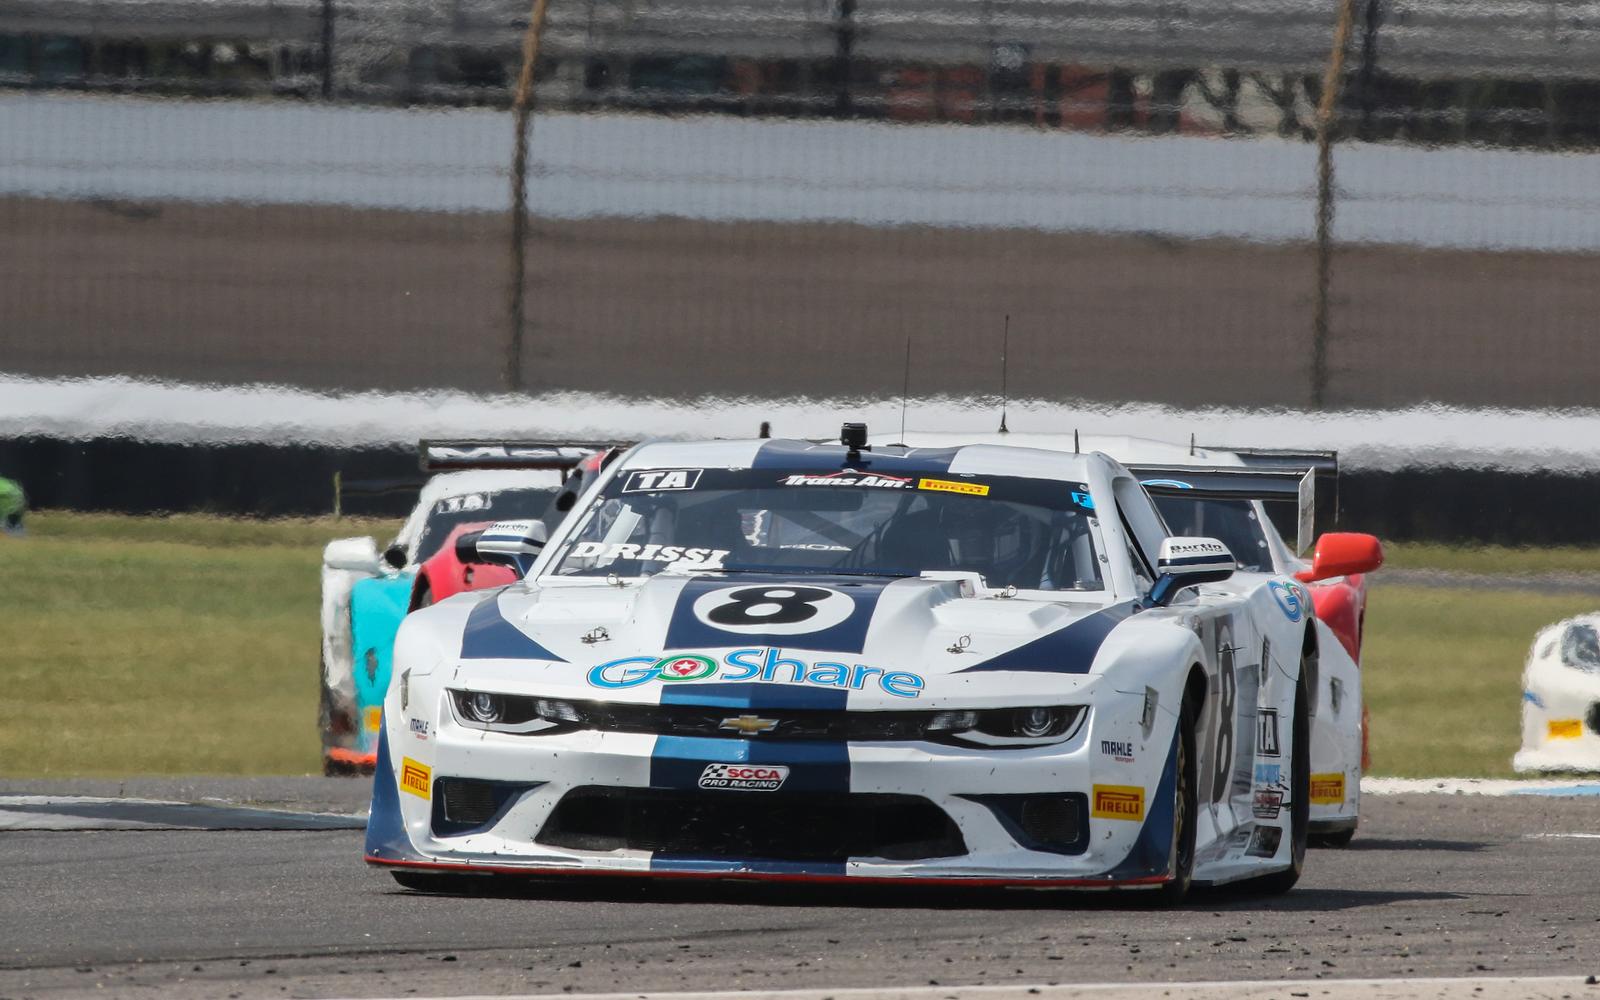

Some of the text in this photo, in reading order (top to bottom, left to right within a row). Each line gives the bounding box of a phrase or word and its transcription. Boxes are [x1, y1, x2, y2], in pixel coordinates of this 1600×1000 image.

[638, 472, 687, 488] TA
[784, 475, 905, 488] Trans Am
[924, 480, 984, 494] PIRELLI
[567, 541, 731, 565] DRISSI
[708, 586, 833, 626] 8
[1213, 643, 1237, 803] 8
[1101, 740, 1132, 757] MAHLE
[403, 765, 428, 793] PIRELLI
[727, 768, 780, 780] SCCA
[702, 779, 779, 789] PRO RACING
[1311, 780, 1342, 799] PIRELLI
[1096, 792, 1139, 814] PIRELLI
